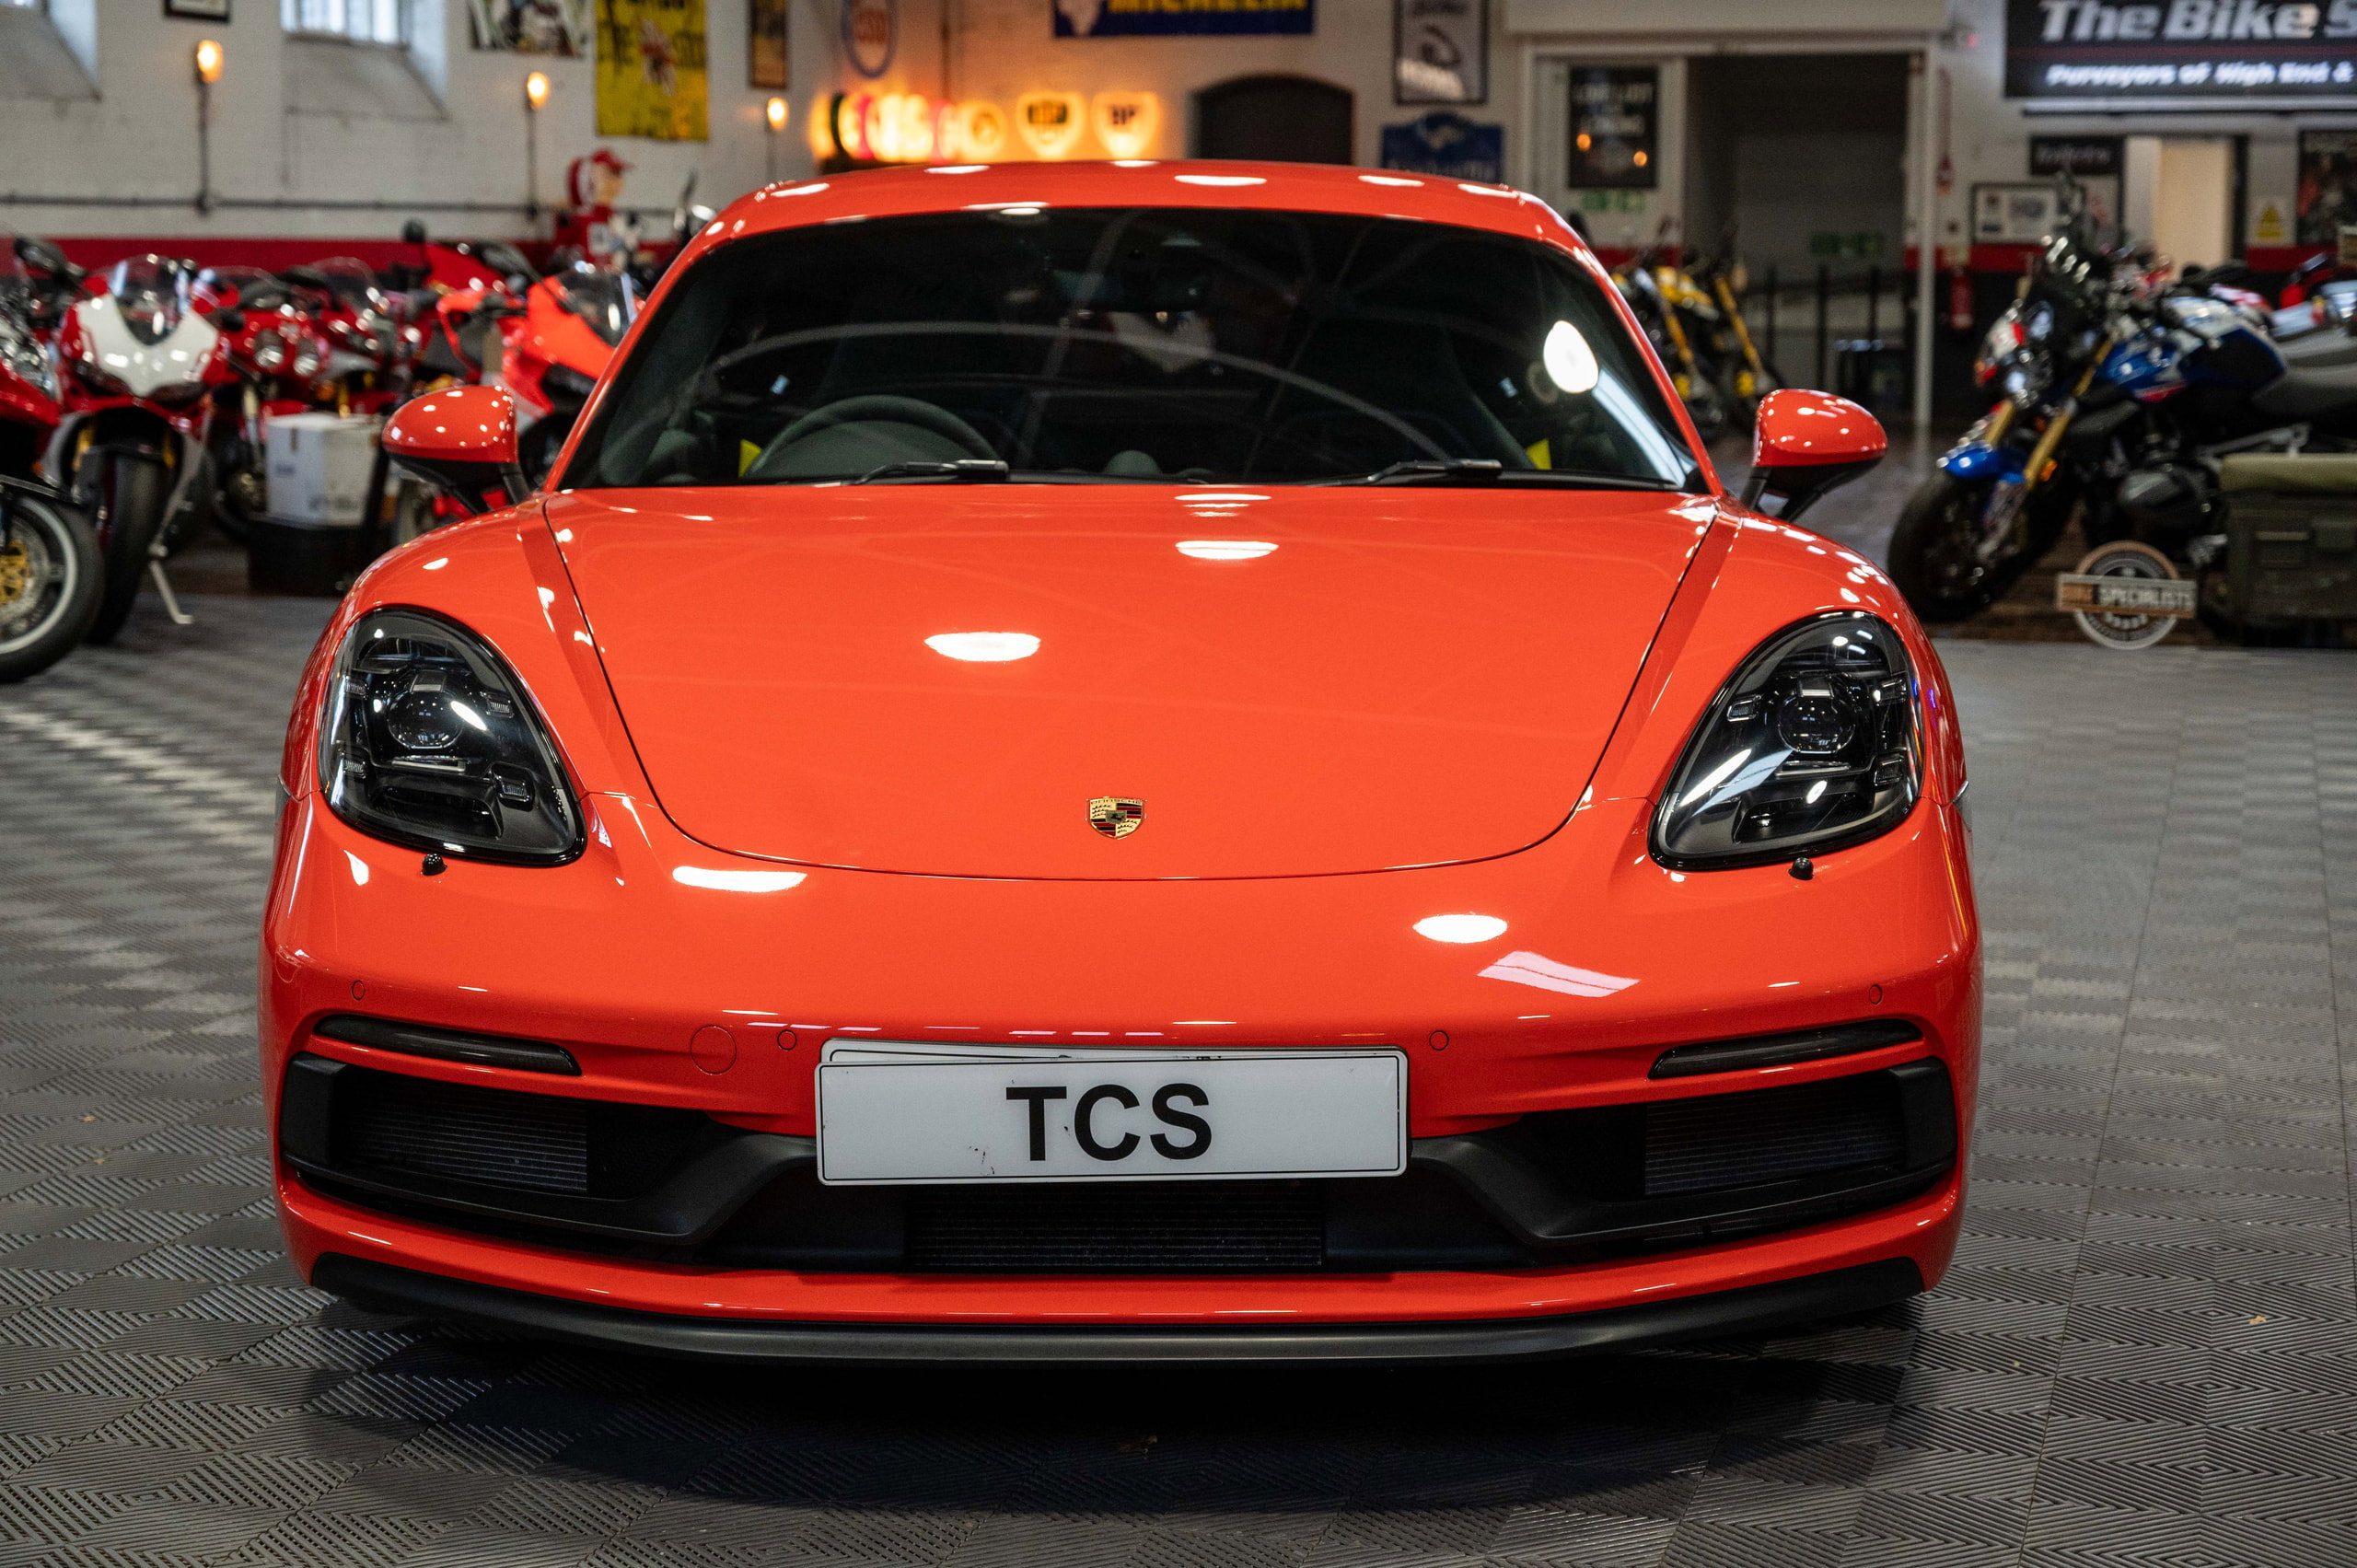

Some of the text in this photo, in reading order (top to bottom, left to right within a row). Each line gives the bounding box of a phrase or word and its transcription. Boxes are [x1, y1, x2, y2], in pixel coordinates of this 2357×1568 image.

[2041, 0, 2161, 41] The
[2165, 0, 2319, 40] Bike
[2046, 64, 2176, 88] Purveyors
[2177, 62, 2212, 85] of
[2214, 61, 2276, 87] High
[2278, 62, 2331, 84] End
[1005, 1083, 1213, 1162] TCS
